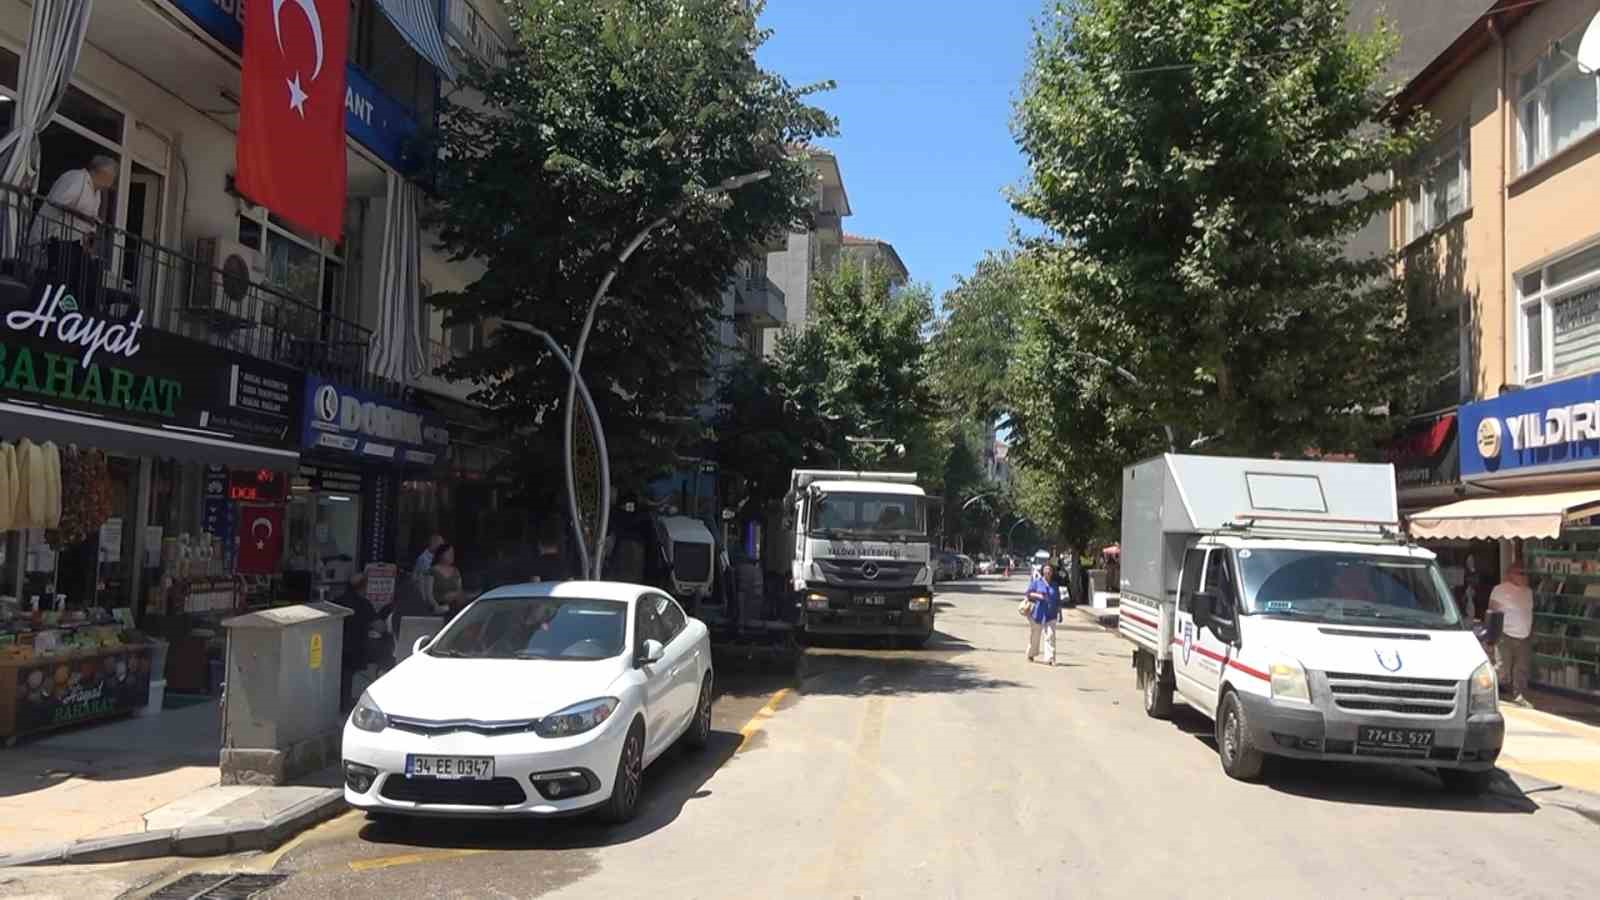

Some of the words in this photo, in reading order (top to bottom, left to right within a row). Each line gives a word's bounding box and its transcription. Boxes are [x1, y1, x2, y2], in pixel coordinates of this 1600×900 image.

[6, 283, 144, 369] Hayat
[1367, 728, 1383, 742] 77
[415, 758, 431, 774] 34
[436, 758, 452, 774] EE
[457, 759, 490, 776] 0347
